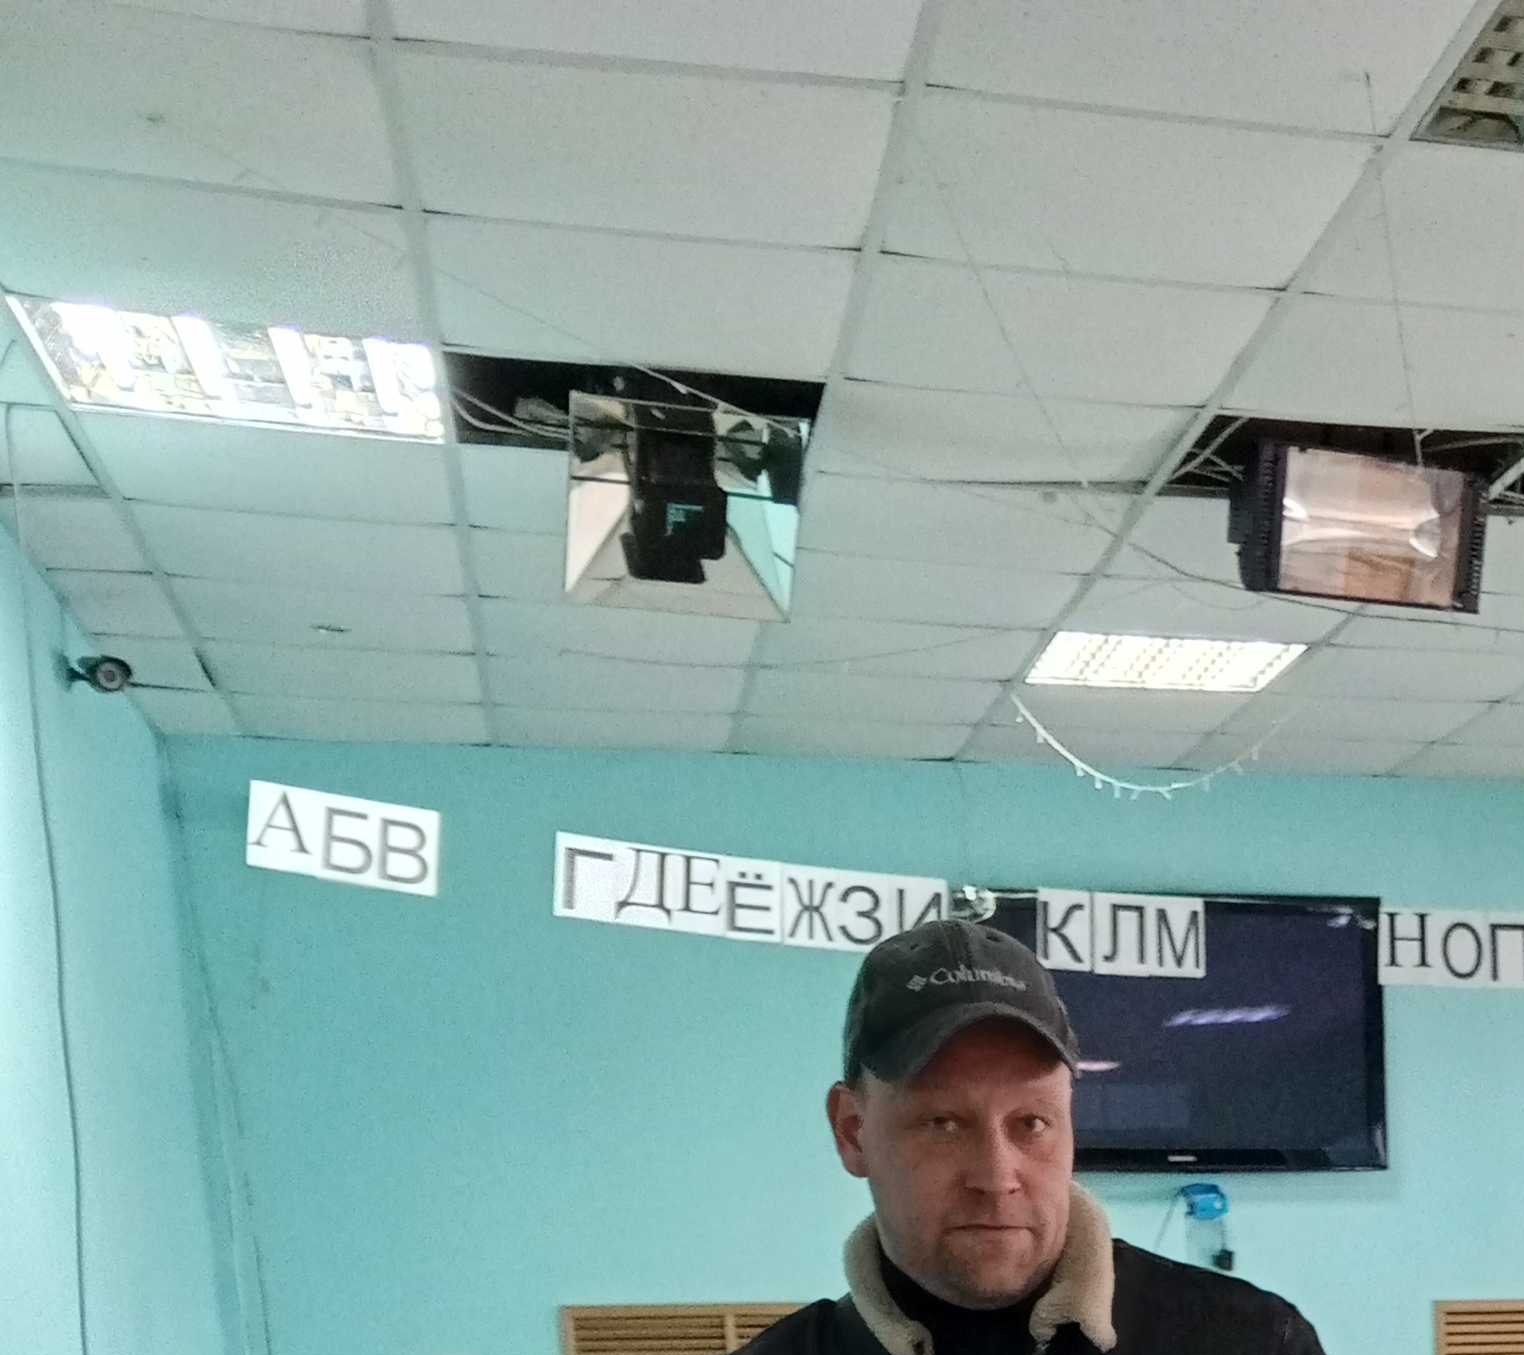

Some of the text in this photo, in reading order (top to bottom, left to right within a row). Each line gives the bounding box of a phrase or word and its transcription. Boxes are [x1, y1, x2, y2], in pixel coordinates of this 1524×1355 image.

[247, 790, 429, 886] АБВ
[563, 846, 942, 945] ГДЕЁЖЗИ
[1041, 899, 1201, 970] КЛМ
